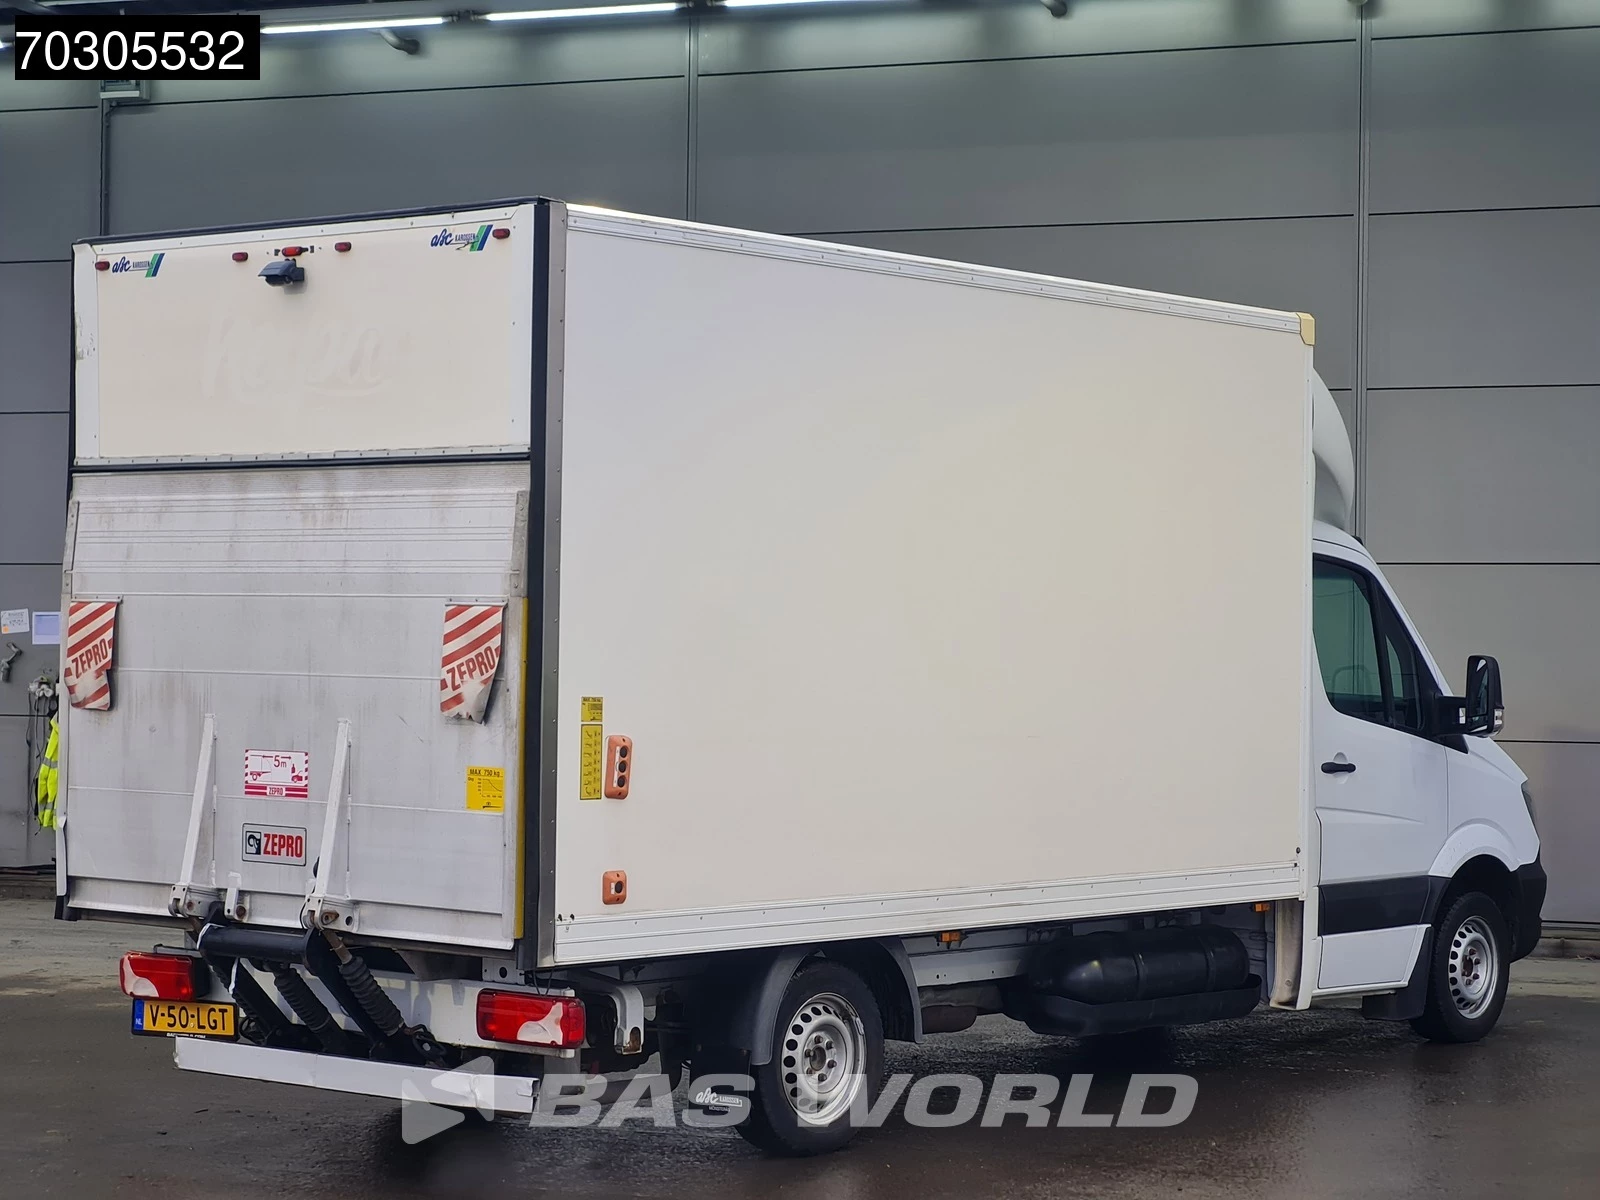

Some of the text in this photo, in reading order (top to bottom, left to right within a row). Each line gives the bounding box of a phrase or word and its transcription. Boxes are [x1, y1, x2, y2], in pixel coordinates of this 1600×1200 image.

[71, 638, 108, 679] ZEPRO
[446, 646, 496, 691] ZEPRO
[493, 770, 500, 778] kg
[268, 786, 284, 797] ZEPRO
[263, 833, 303, 858] ZEPRO
[135, 1004, 228, 1031] NL V-50-LGT
